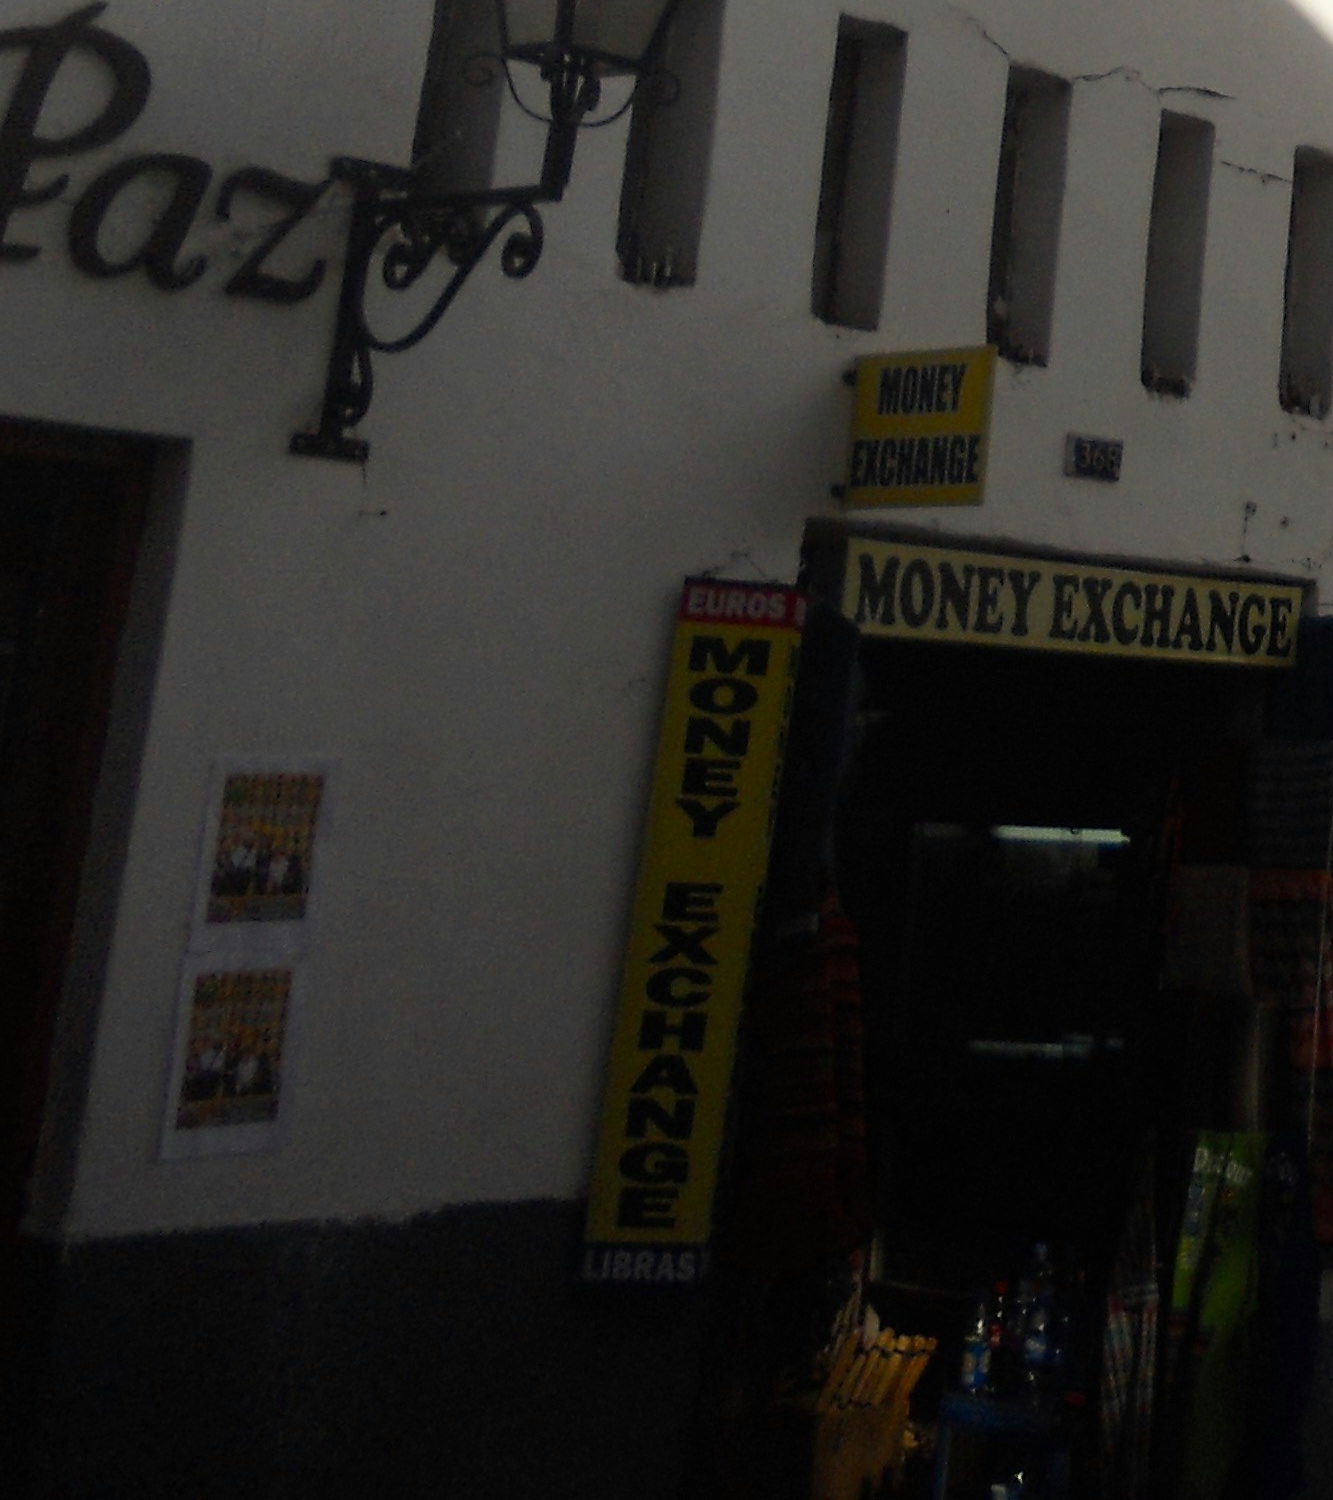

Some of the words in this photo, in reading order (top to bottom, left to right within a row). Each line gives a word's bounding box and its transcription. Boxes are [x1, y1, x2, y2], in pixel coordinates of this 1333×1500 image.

[877, 363, 967, 416] MONEY
[851, 433, 981, 489] EXCHANGE
[687, 586, 787, 620] EUROS
[855, 552, 1041, 638] MONEY
[1049, 572, 1294, 658] EXCHANGE
[675, 635, 772, 838] MONEY
[616, 882, 724, 1229] EXCHANGE
[583, 1249, 697, 1282] LIBRAS
